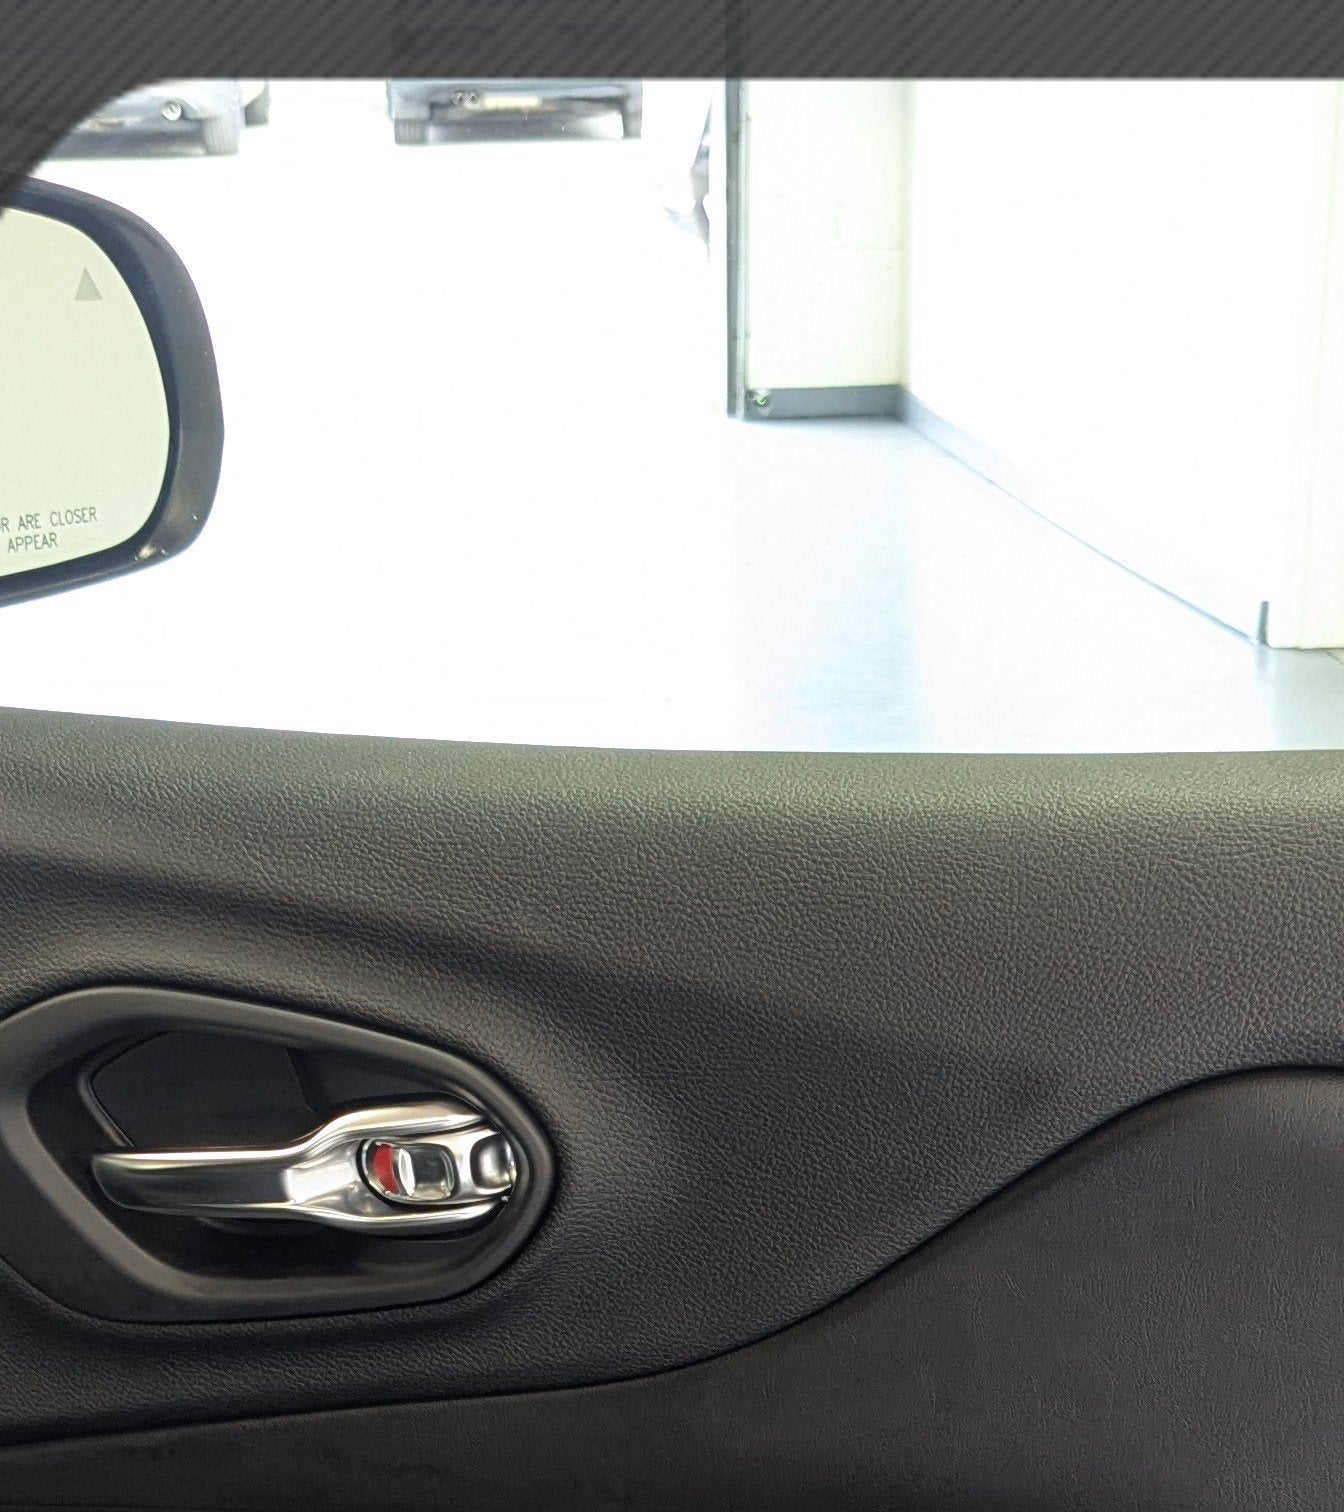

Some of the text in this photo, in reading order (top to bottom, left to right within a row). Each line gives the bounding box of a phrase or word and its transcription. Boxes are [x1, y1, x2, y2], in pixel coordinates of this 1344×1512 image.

[18, 513, 42, 531] ARE
[50, 506, 98, 528] CLOSER
[7, 532, 58, 554] APPEAR
